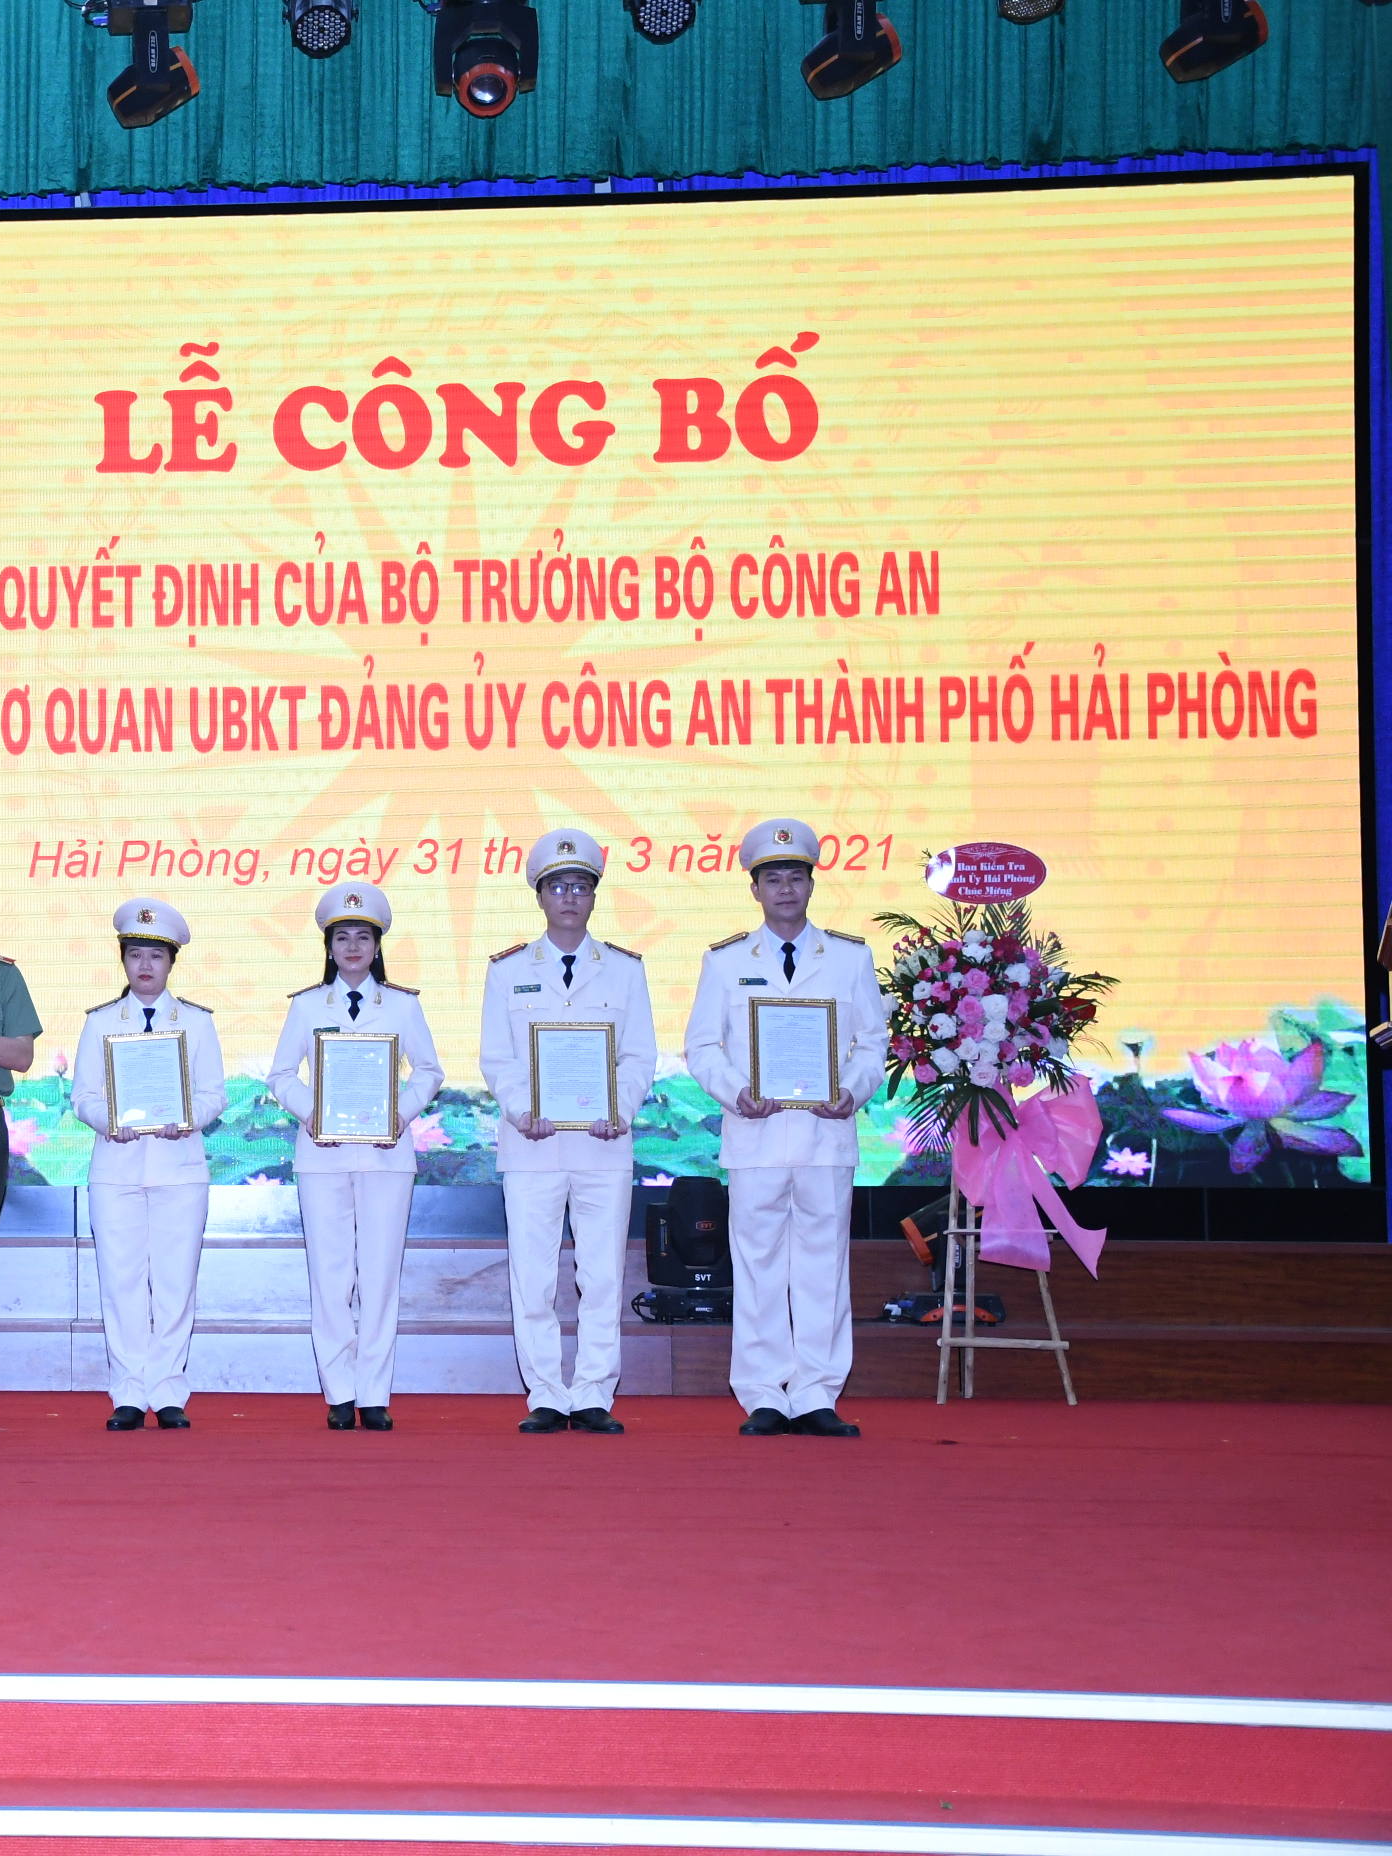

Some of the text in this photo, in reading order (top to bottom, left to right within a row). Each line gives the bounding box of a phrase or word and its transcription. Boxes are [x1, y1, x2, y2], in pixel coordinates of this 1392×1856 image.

[94, 331, 820, 474] LỄ CÔNG BỐ
[152, 563, 260, 648] ĐỊNH
[274, 531, 369, 627] CỦA
[381, 541, 440, 647] BỘ
[453, 528, 640, 624] TRƯỞNG
[654, 536, 715, 642] BỘ
[729, 534, 861, 620] CÔNG
[875, 551, 940, 616] AN
[45, 687, 174, 755] QUAN
[189, 685, 307, 754] UBKT
[317, 654, 450, 752] ĐẢNG
[464, 651, 527, 751] ỦY
[541, 661, 672, 750] CÔNG
[685, 679, 752, 746] AN
[765, 658, 925, 745] THÀNH
[939, 641, 1036, 745] PHỐ
[1050, 642, 1131, 743] HẢI
[1147, 651, 1318, 741] PHÒNG
[28, 838, 103, 878] Hải
[117, 838, 270, 885] Phòng,
[290, 837, 399, 885] ngày
[413, 838, 464, 875] 31
[626, 836, 653, 873] 3
[816, 834, 893, 871] 021
[958, 862, 977, 871] Ban
[1007, 862, 1026, 870] Tra
[958, 886, 982, 895] Chúc
[1004, 874, 1035, 884] Phòng
